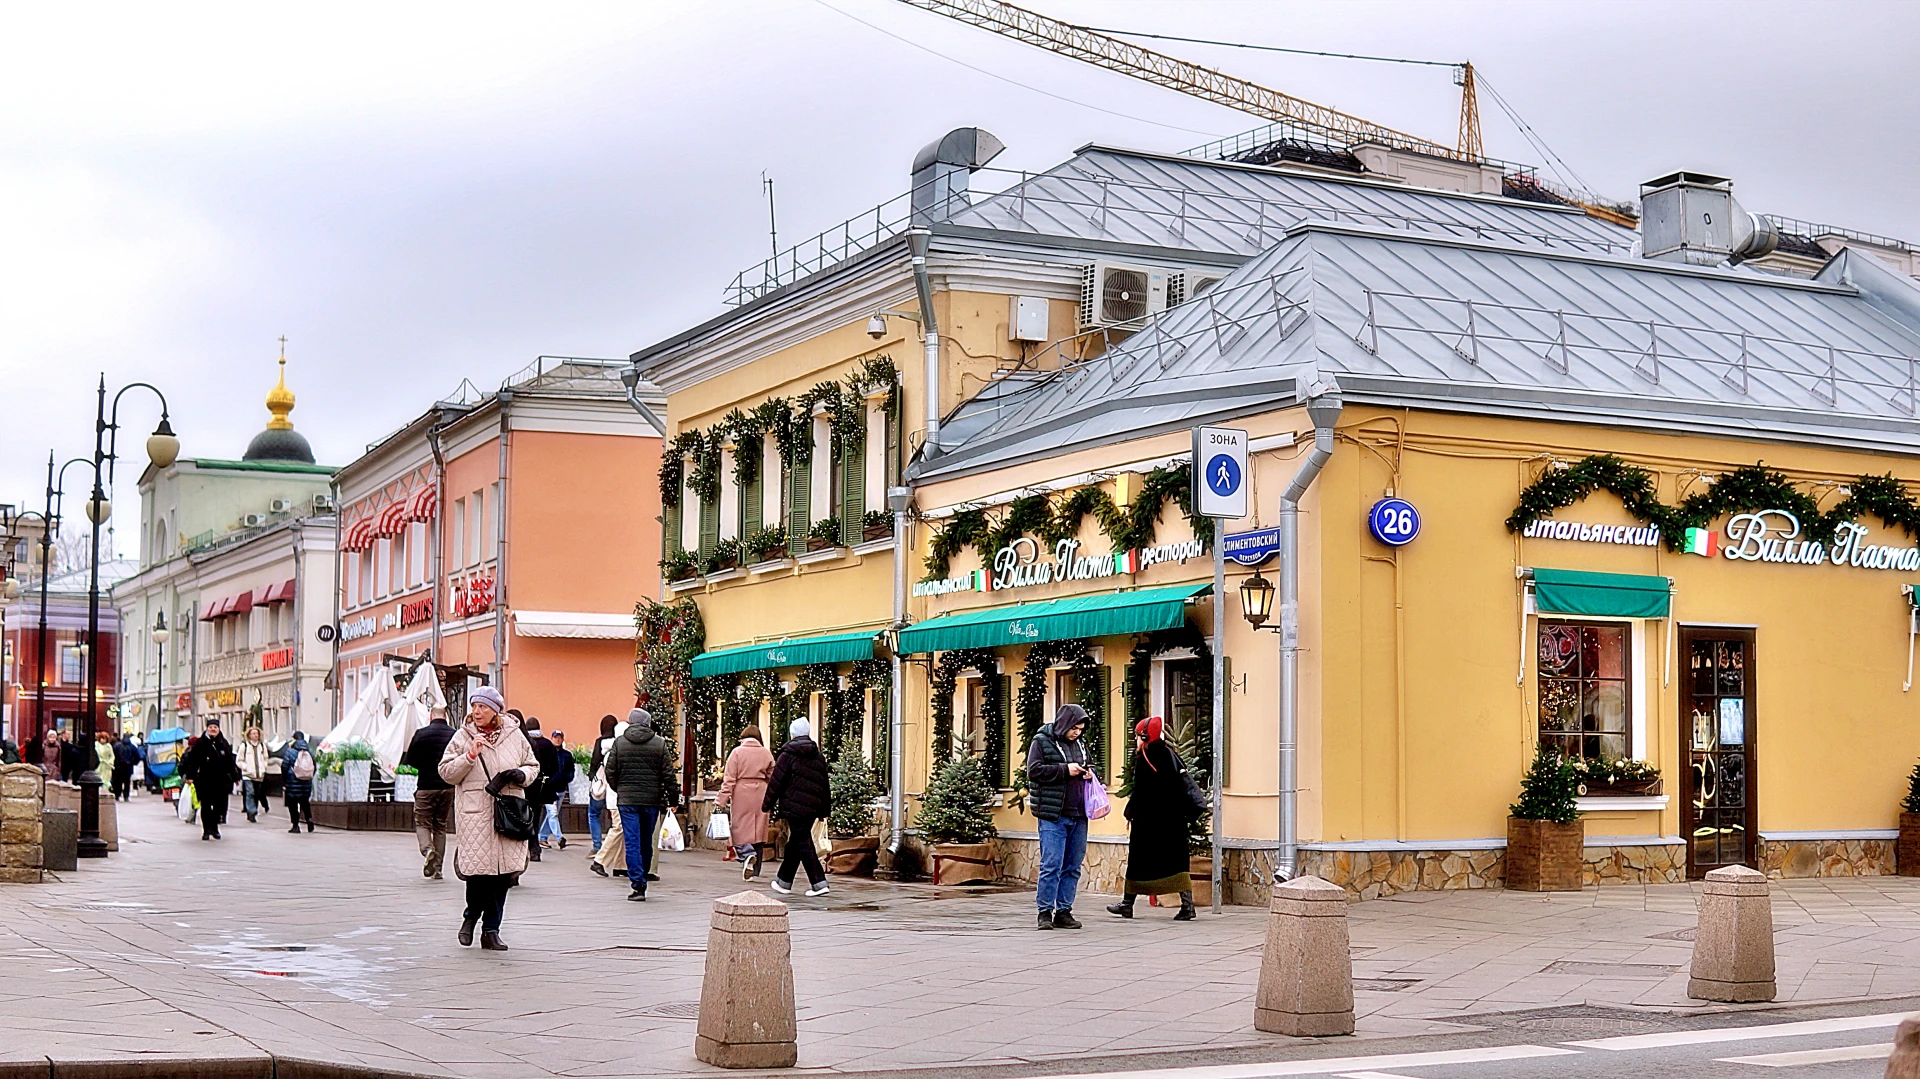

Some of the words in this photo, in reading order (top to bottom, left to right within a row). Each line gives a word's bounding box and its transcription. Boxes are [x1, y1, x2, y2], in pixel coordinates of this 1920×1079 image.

[1210, 434, 1237, 446] ЗОНА
[1384, 508, 1412, 535] 26
[1523, 518, 1660, 547] итальянский
[1725, 509, 1825, 565] Вилла
[1831, 521, 1920, 572] Паста
[912, 569, 973, 598] итальянский
[993, 538, 1052, 591] Вилла
[1054, 538, 1115, 583] Паста
[1140, 539, 1203, 570] ресторан
